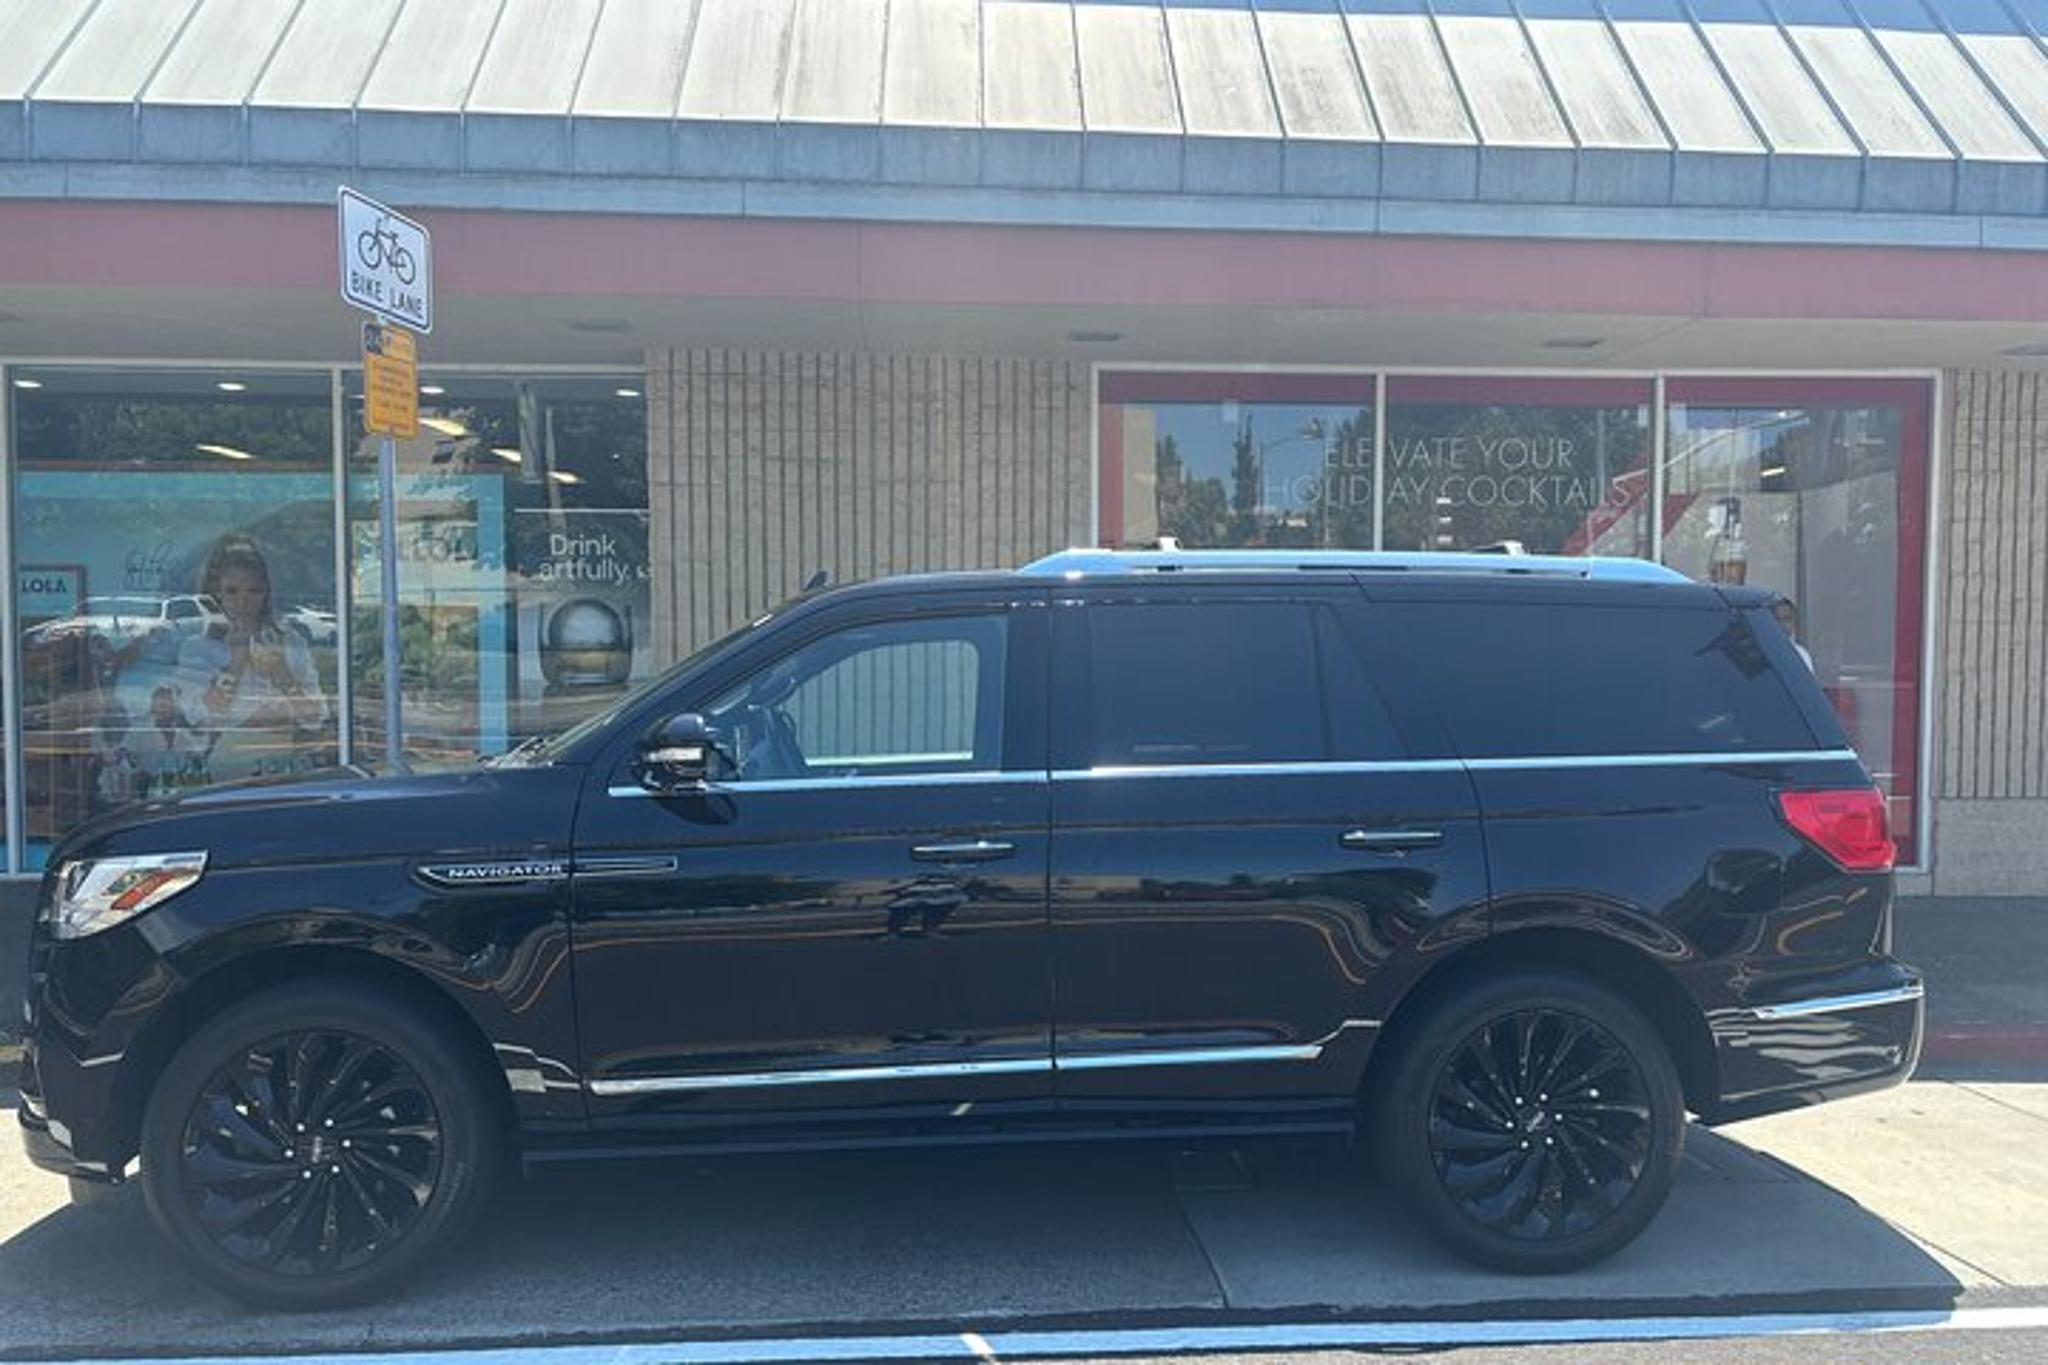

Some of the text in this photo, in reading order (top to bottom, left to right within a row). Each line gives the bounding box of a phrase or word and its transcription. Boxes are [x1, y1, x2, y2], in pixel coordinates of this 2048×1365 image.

[352, 271, 424, 319] BIKE LANE
[1325, 437, 1573, 469] ELEVATE YOUR
[1264, 475, 1631, 506] HOLIDAY COCKTAILS
[550, 533, 616, 556] Drink
[21, 578, 67, 593] LOLA
[449, 864, 561, 877] NAVIGATOR
